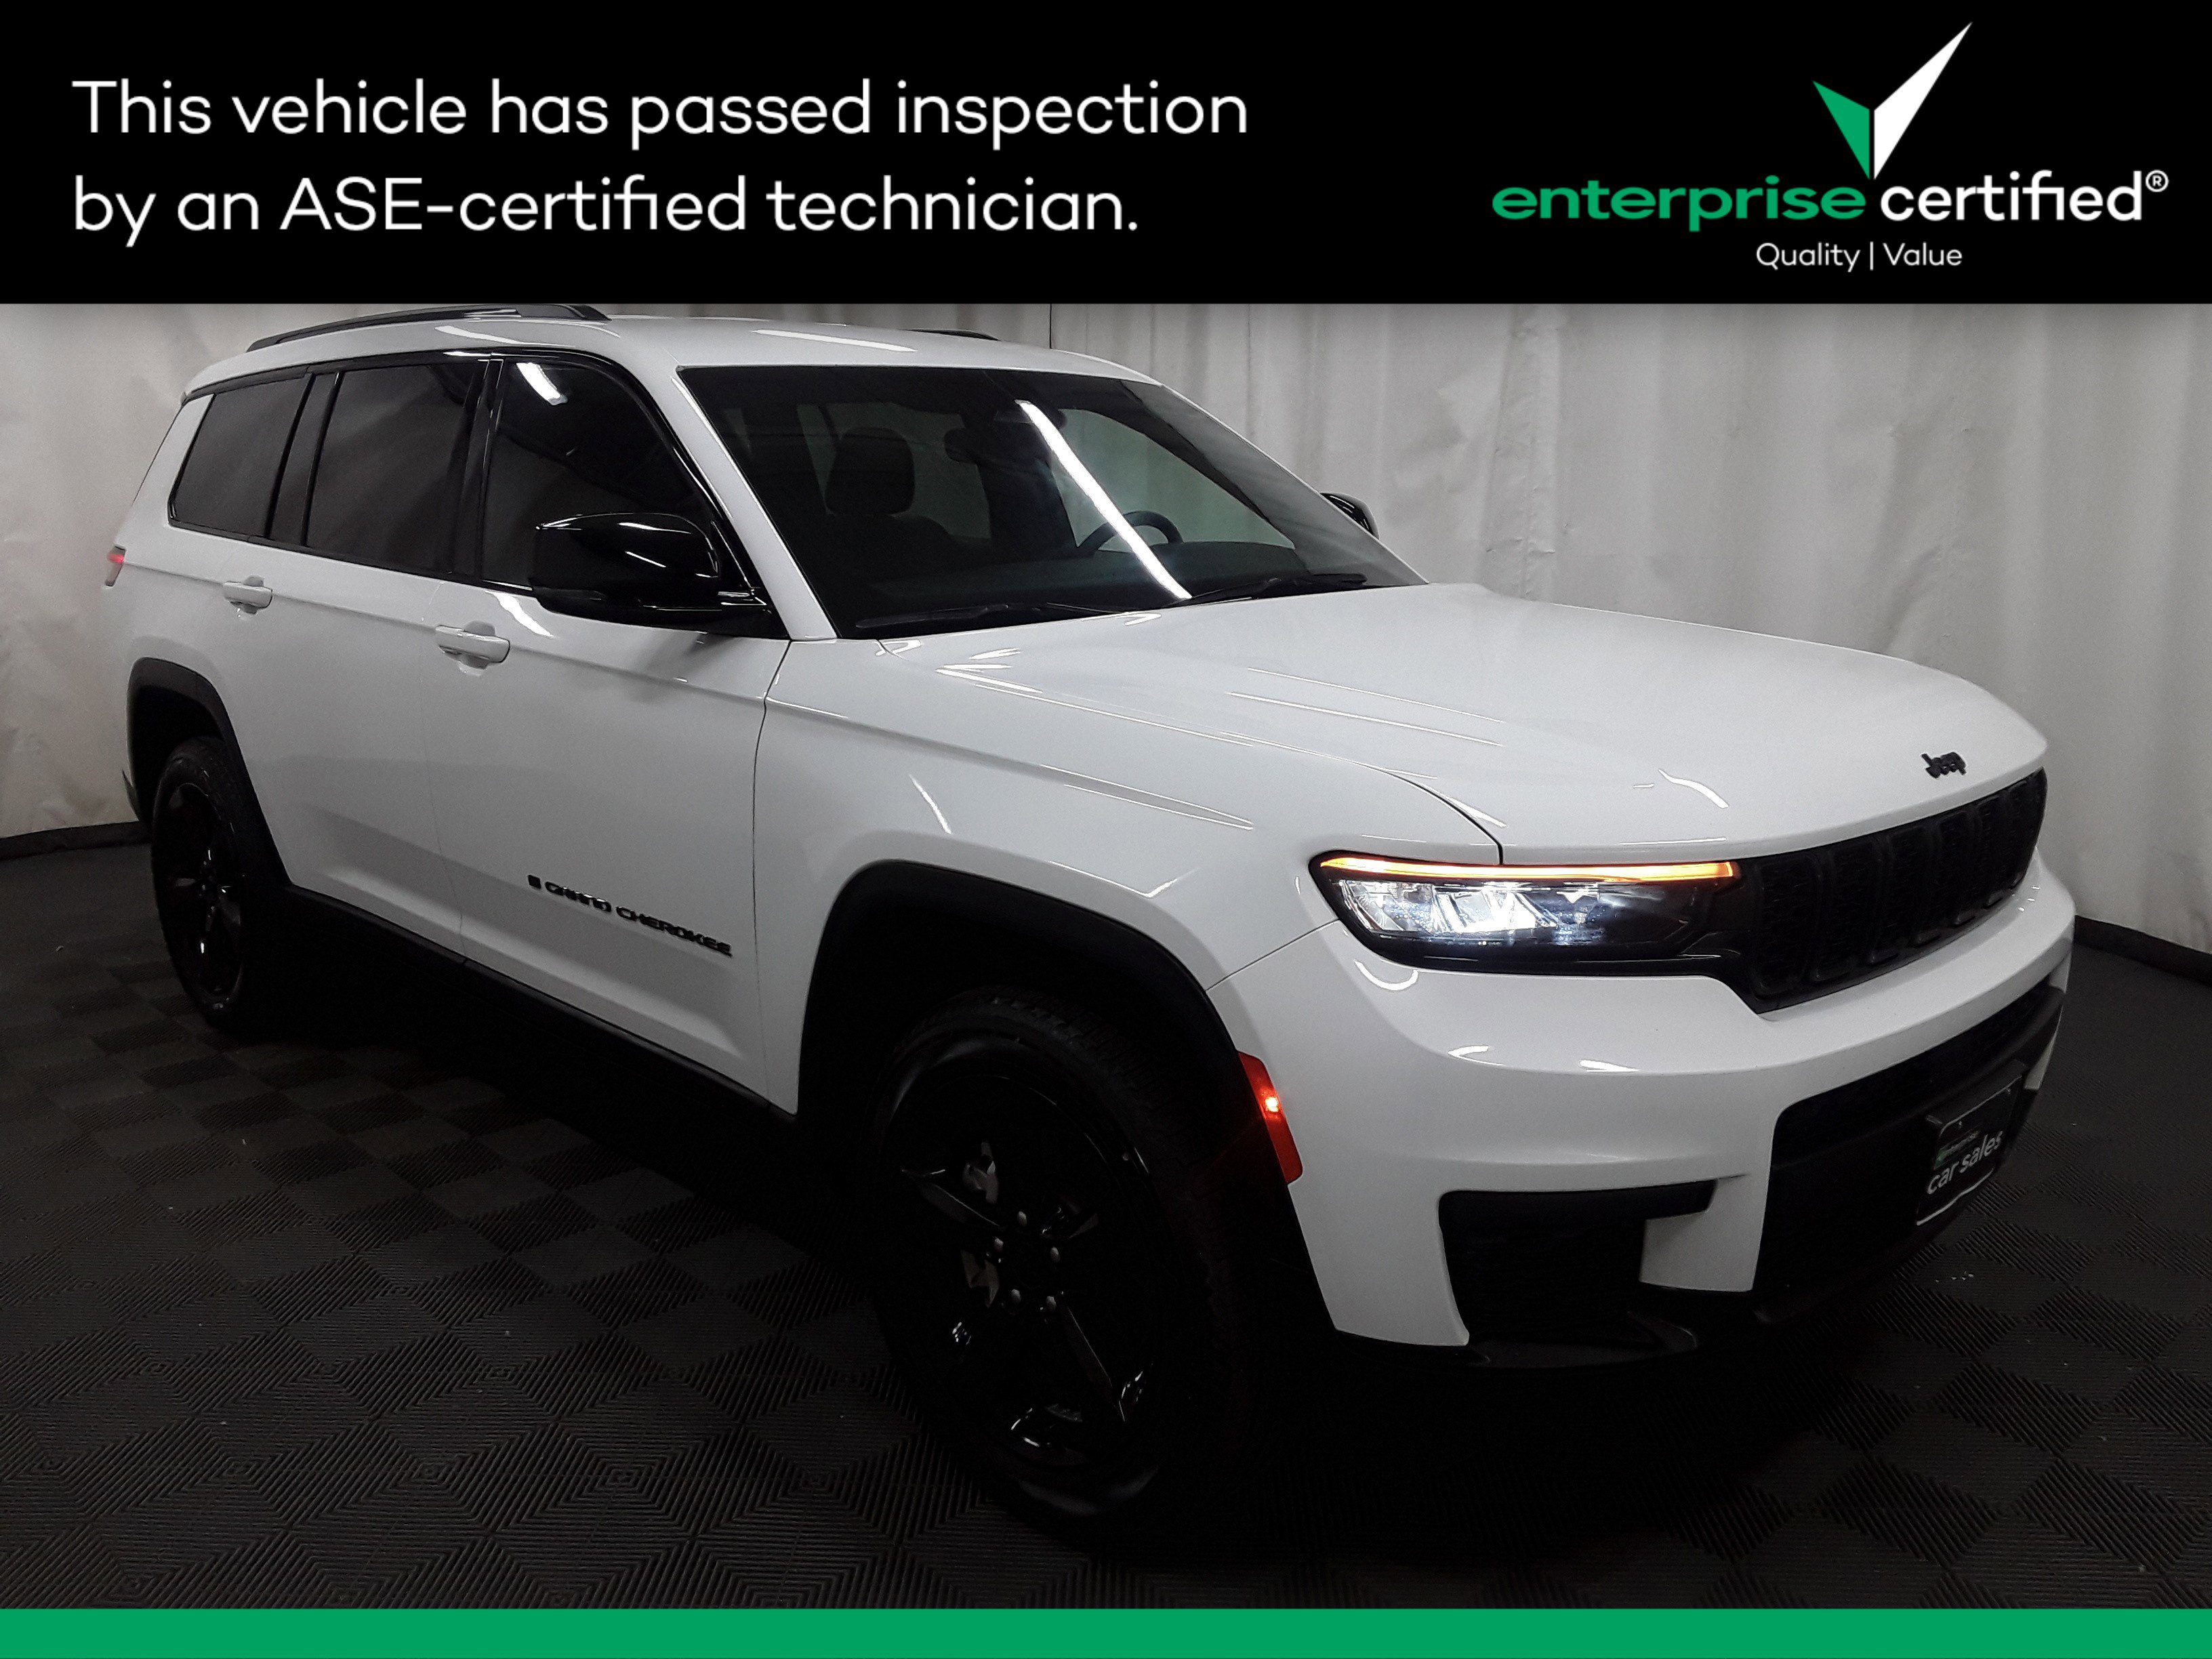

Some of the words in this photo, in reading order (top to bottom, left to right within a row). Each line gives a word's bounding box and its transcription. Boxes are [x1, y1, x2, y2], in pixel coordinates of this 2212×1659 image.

[1921, 752, 1966, 779] Jeep
[616, 906, 733, 958] CHEROKEE
[1927, 1161, 1960, 1195] car
[1959, 1130, 2003, 1174] sales
